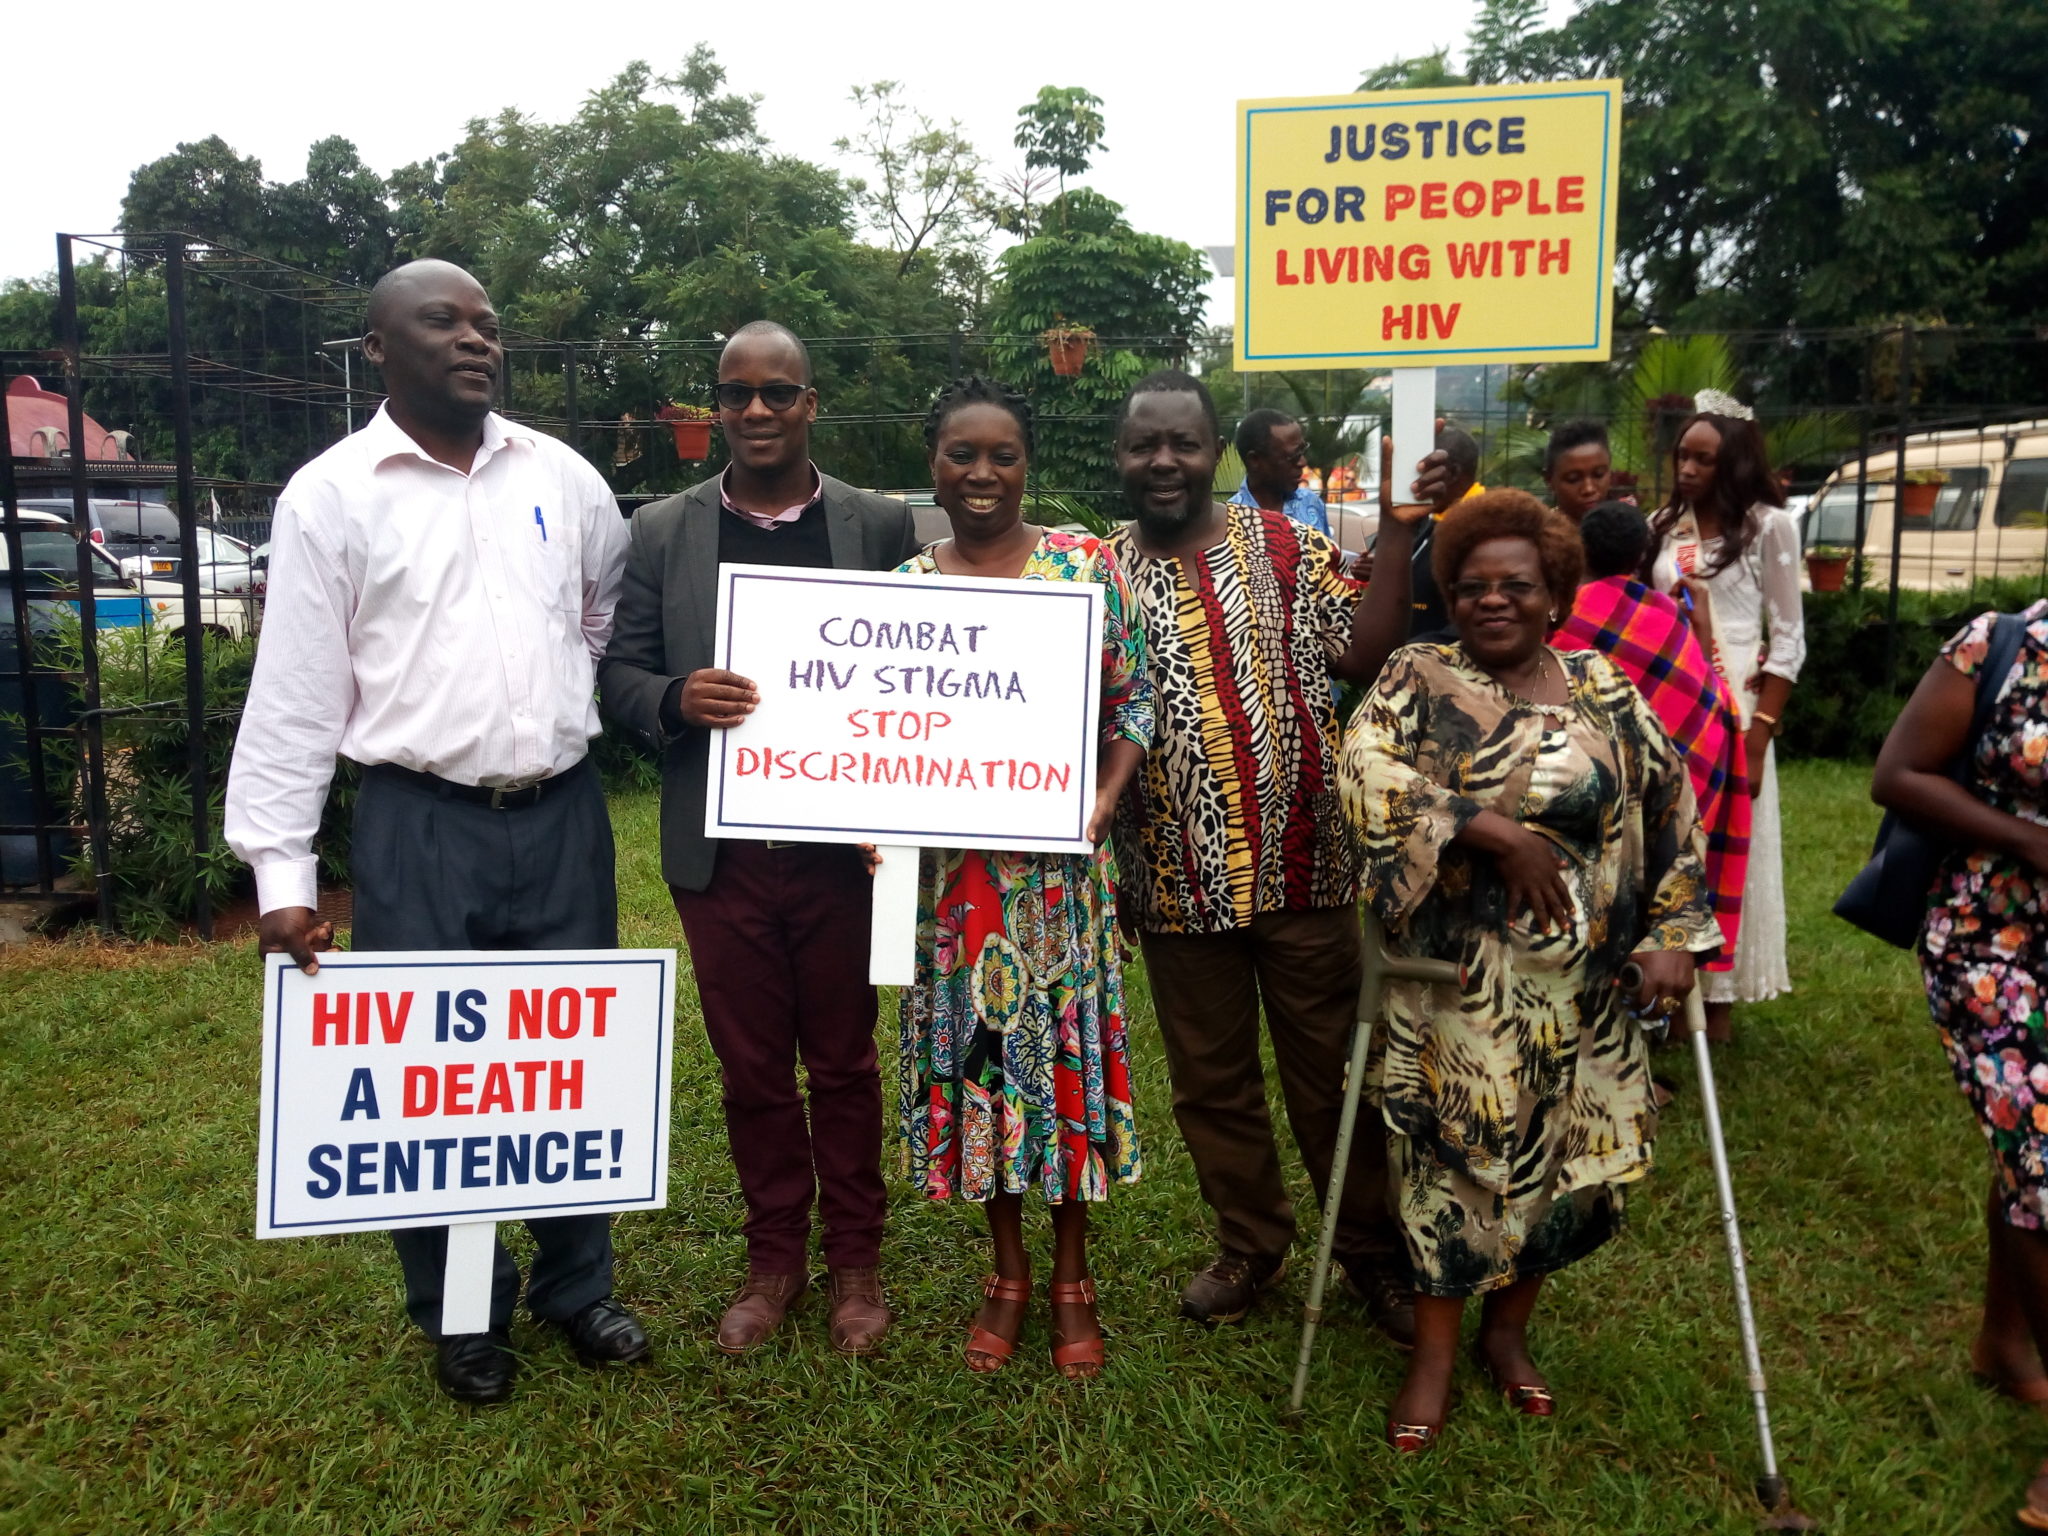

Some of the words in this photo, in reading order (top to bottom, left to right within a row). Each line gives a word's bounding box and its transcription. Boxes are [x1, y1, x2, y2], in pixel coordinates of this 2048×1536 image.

[1324, 116, 1526, 164] JUSTICE
[1264, 185, 1366, 227] FOR
[1384, 175, 1585, 222] PEOPLE
[1275, 243, 1431, 286] LIVING
[1446, 237, 1571, 279] WITH
[1381, 302, 1462, 341] HIV
[819, 616, 988, 655] COMBAT
[789, 659, 857, 691] HIV
[873, 664, 1027, 703] STIGMA
[846, 708, 953, 741] STOP
[735, 746, 1071, 793] DISCRIMINATION
[311, 990, 415, 1047] HIV
[434, 988, 488, 1044] IS
[507, 986, 617, 1041] NOT
[339, 1066, 381, 1122] A
[402, 1058, 584, 1118] DEATH
[305, 1128, 624, 1200] SENTENCE!
